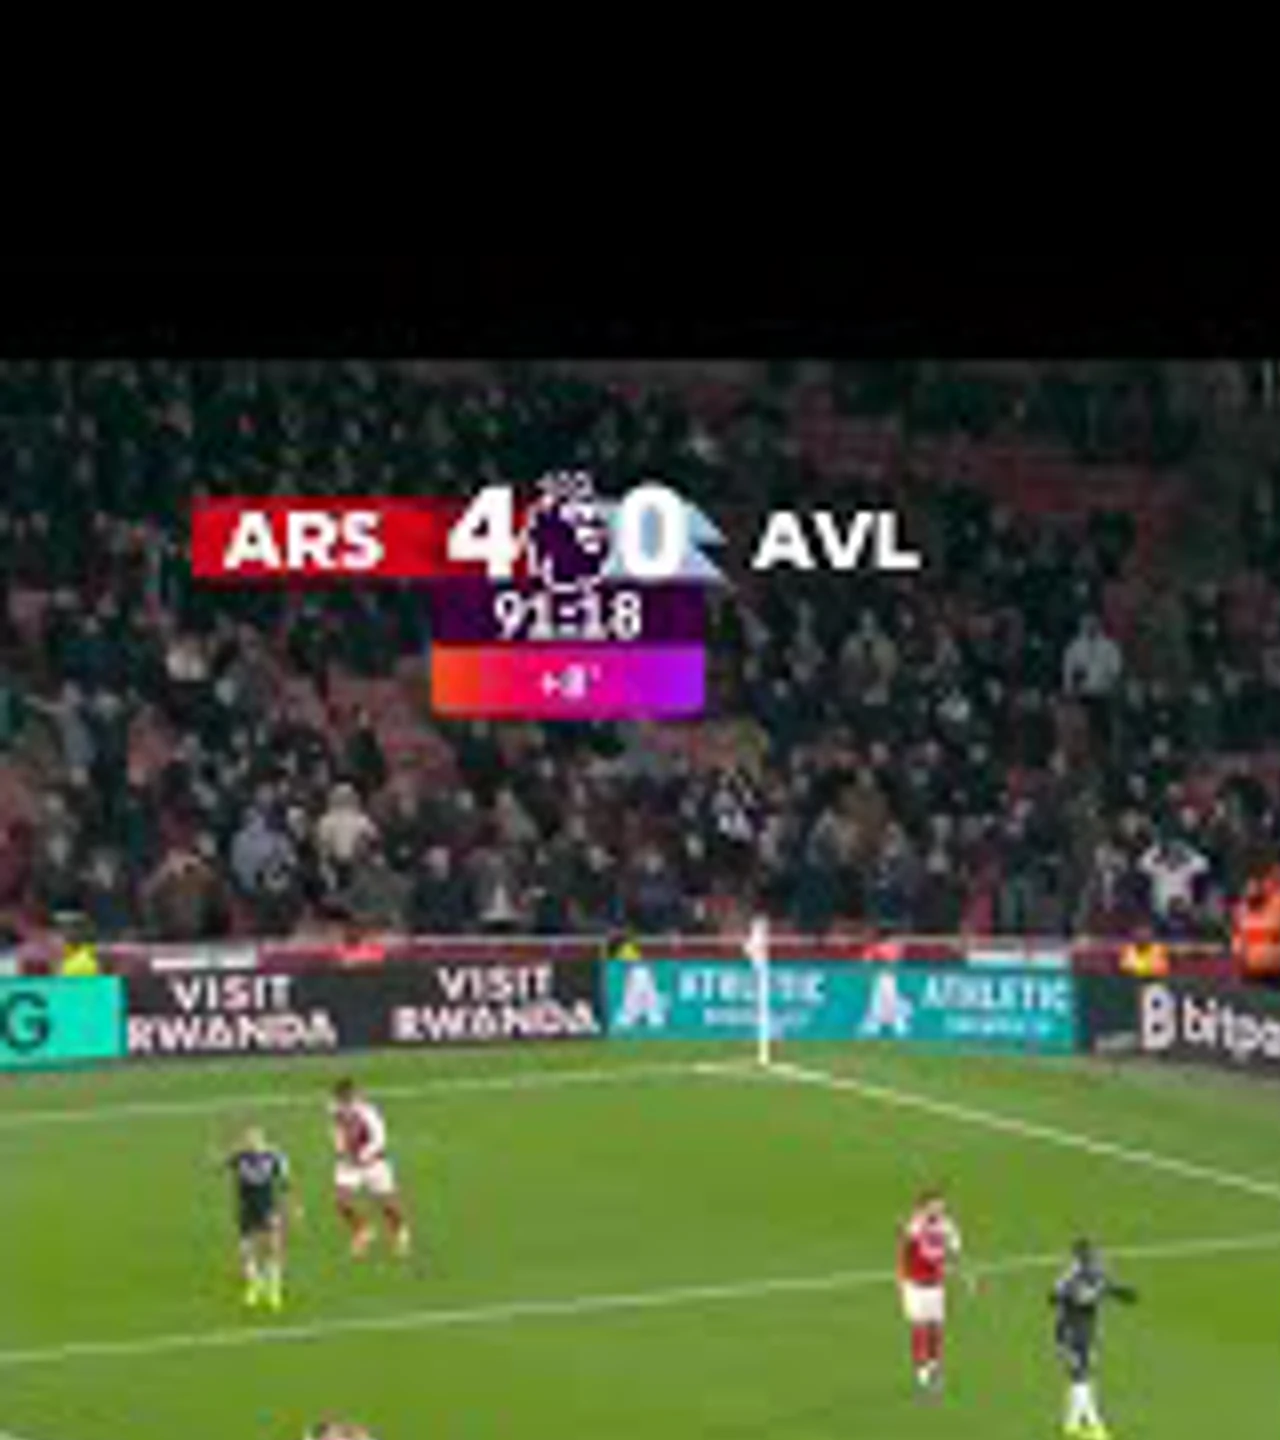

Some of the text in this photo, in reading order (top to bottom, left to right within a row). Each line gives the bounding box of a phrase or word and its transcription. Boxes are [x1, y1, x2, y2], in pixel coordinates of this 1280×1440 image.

[171, 974, 293, 1011] VISIT
[436, 965, 554, 1002] VISIT
[127, 1009, 338, 1051] RWANDA
[391, 1001, 600, 1042] RWANDA
